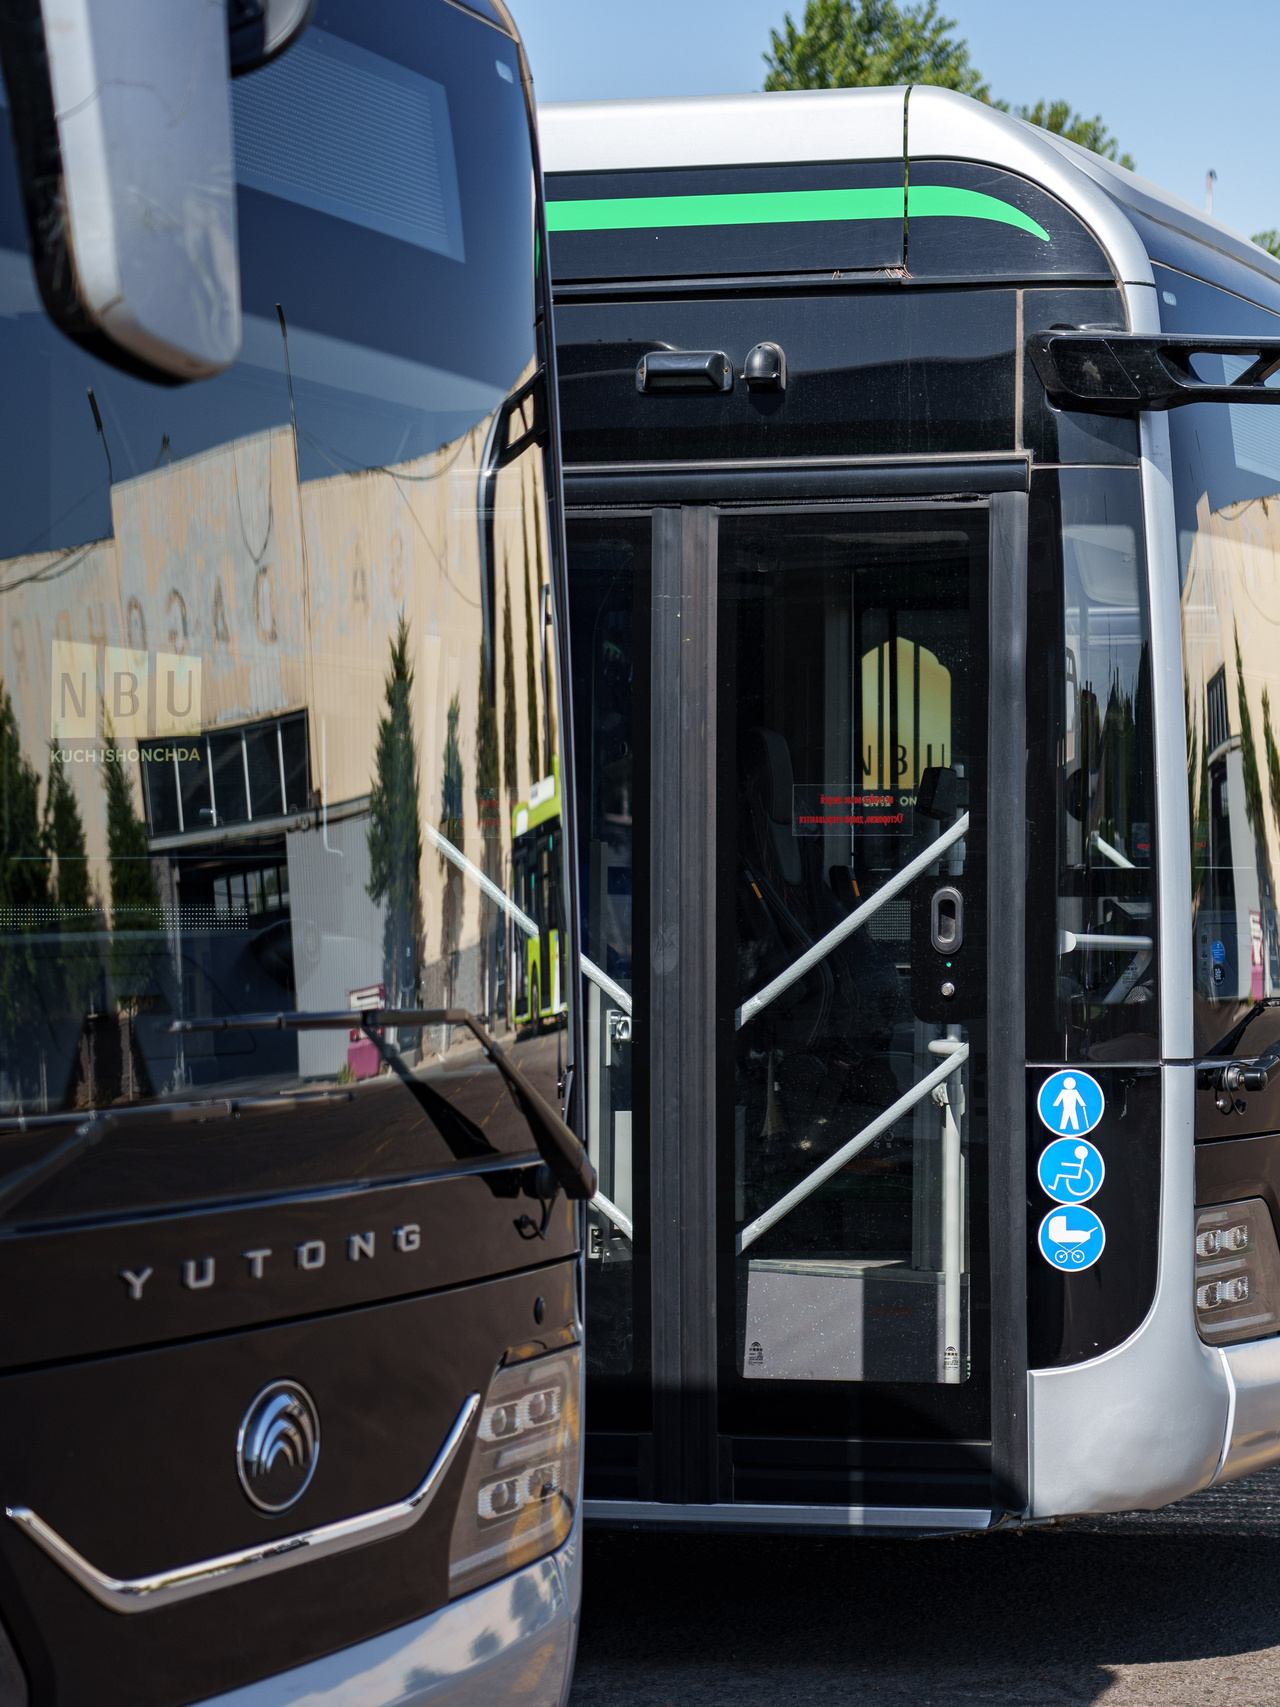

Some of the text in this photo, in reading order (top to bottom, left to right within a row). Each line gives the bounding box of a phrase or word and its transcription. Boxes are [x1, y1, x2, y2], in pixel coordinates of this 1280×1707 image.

[61, 670, 192, 718] NBU
[51, 748, 201, 763] KUCH ISHONCHDA
[118, 1224, 421, 1300] YUTONG
